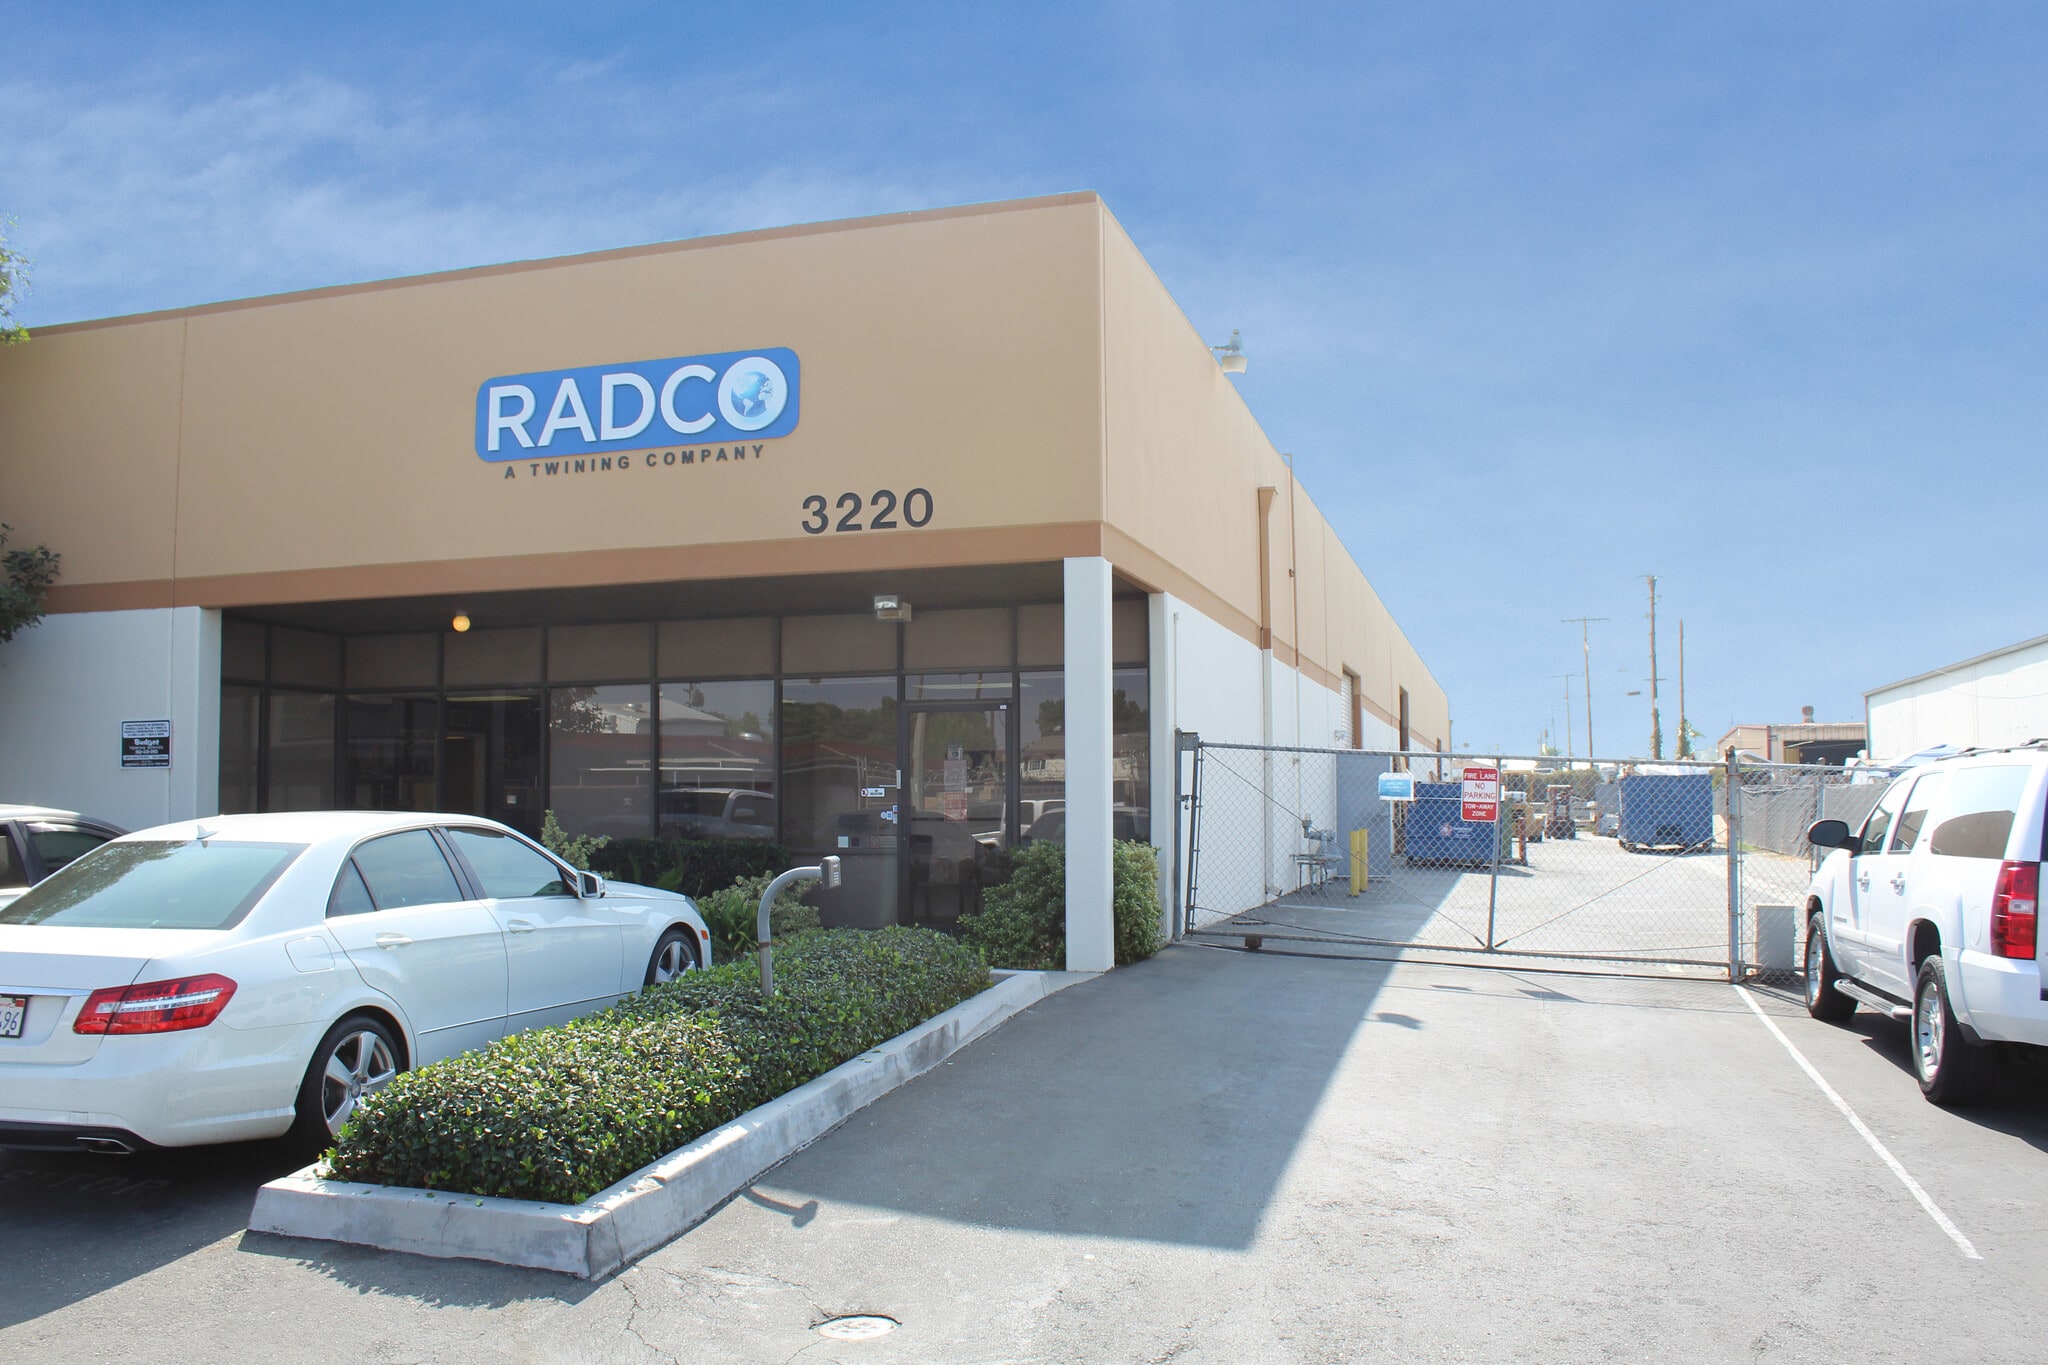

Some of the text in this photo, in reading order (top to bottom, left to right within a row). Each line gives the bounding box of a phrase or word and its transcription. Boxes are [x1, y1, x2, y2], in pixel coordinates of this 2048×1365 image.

[487, 356, 787, 451] RADCO
[504, 445, 764, 479] A TWINING COMPANY
[801, 487, 934, 535] 3220
[1464, 772, 1496, 780] FIRE LANE
[1474, 782, 1485, 790] NO
[1464, 791, 1496, 800] PARKING
